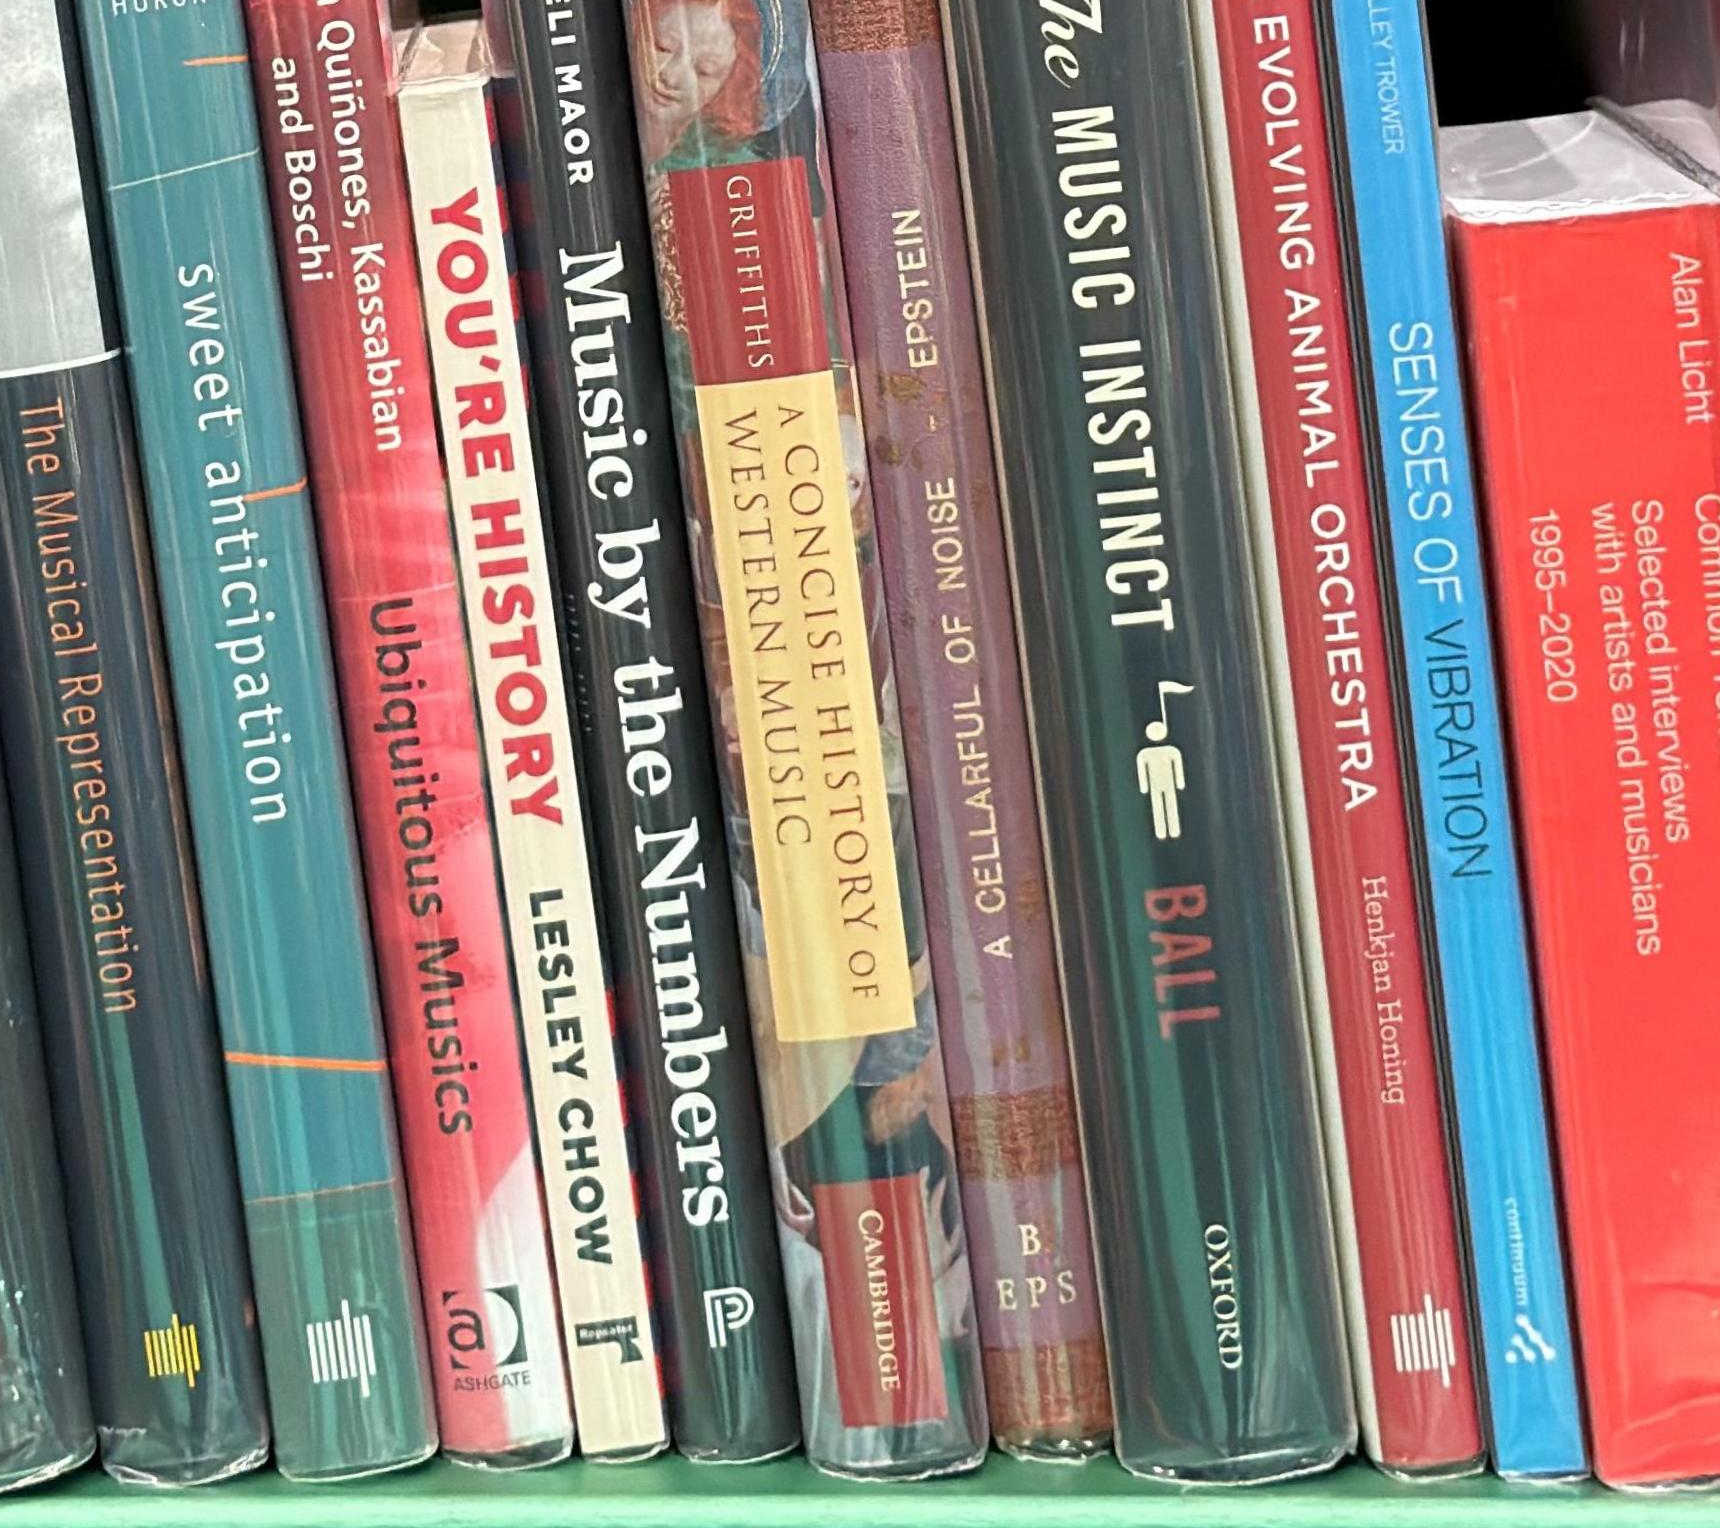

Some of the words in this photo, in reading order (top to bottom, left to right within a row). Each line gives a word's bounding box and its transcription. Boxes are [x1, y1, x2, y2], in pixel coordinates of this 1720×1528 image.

[270, 56, 312, 136] and
[554, 63, 594, 186] MAOR
[1255, 15, 1313, 272] EVOLVING
[1378, 58, 1406, 156] TROWER
[282, 147, 336, 283] Boschi
[316, 17, 372, 234] Quiñones,
[348, 242, 404, 452] Kassabian
[725, 175, 775, 371] GRIFFITHS
[1051, 105, 1137, 309] MUSIC
[178, 263, 243, 432] sweet
[891, 207, 940, 369] EPSTEIN
[1670, 251, 1703, 329] Alan
[21, 397, 63, 478] The
[560, 242, 648, 501] Music
[778, 406, 803, 427] A
[1285, 288, 1339, 490] ANIMAL
[1389, 322, 1452, 523] SENSES
[1679, 339, 1716, 424] Licht
[780, 444, 845, 680] CONCISE
[926, 476, 967, 591] NOISE
[1079, 339, 1176, 634] INSTINCT
[1591, 502, 1621, 575] with
[31, 488, 97, 668] Musical
[205, 467, 287, 824] anticipation
[588, 518, 661, 629] by
[724, 409, 786, 658] WESTERN
[757, 677, 812, 848] MUSIC
[941, 613, 977, 668] OF
[1414, 538, 1461, 606] OF
[1599, 582, 1635, 694] artists
[1631, 499, 1670, 654] Selected
[611, 656, 685, 797] the
[1310, 503, 1378, 813] ORCHESTRA
[1612, 702, 1649, 769] and
[817, 700, 878, 934] HISTORY
[953, 684, 1007, 919] CELLARFUL
[1423, 619, 1492, 880] VIBRATION
[1650, 663, 1690, 843] interviews
[58, 675, 138, 1014] Representation
[369, 598, 444, 934] Ubiquitous
[416, 936, 480, 1134] Musics
[471, 501, 564, 826] HISTORY
[529, 889, 588, 1084] LESLEY
[563, 1096, 613, 1267] CHOW
[1621, 776, 1660, 956] musicians
[852, 951, 880, 1000] OF
[984, 934, 1014, 960] A
[1143, 884, 1221, 1041] BALL
[1362, 874, 1395, 994] Henkjan
[635, 822, 729, 1229] Numbers
[1372, 1001, 1406, 1106] Honing
[1203, 1223, 1244, 1371] OXFORD
[454, 1370, 531, 1391] ASHGATE
